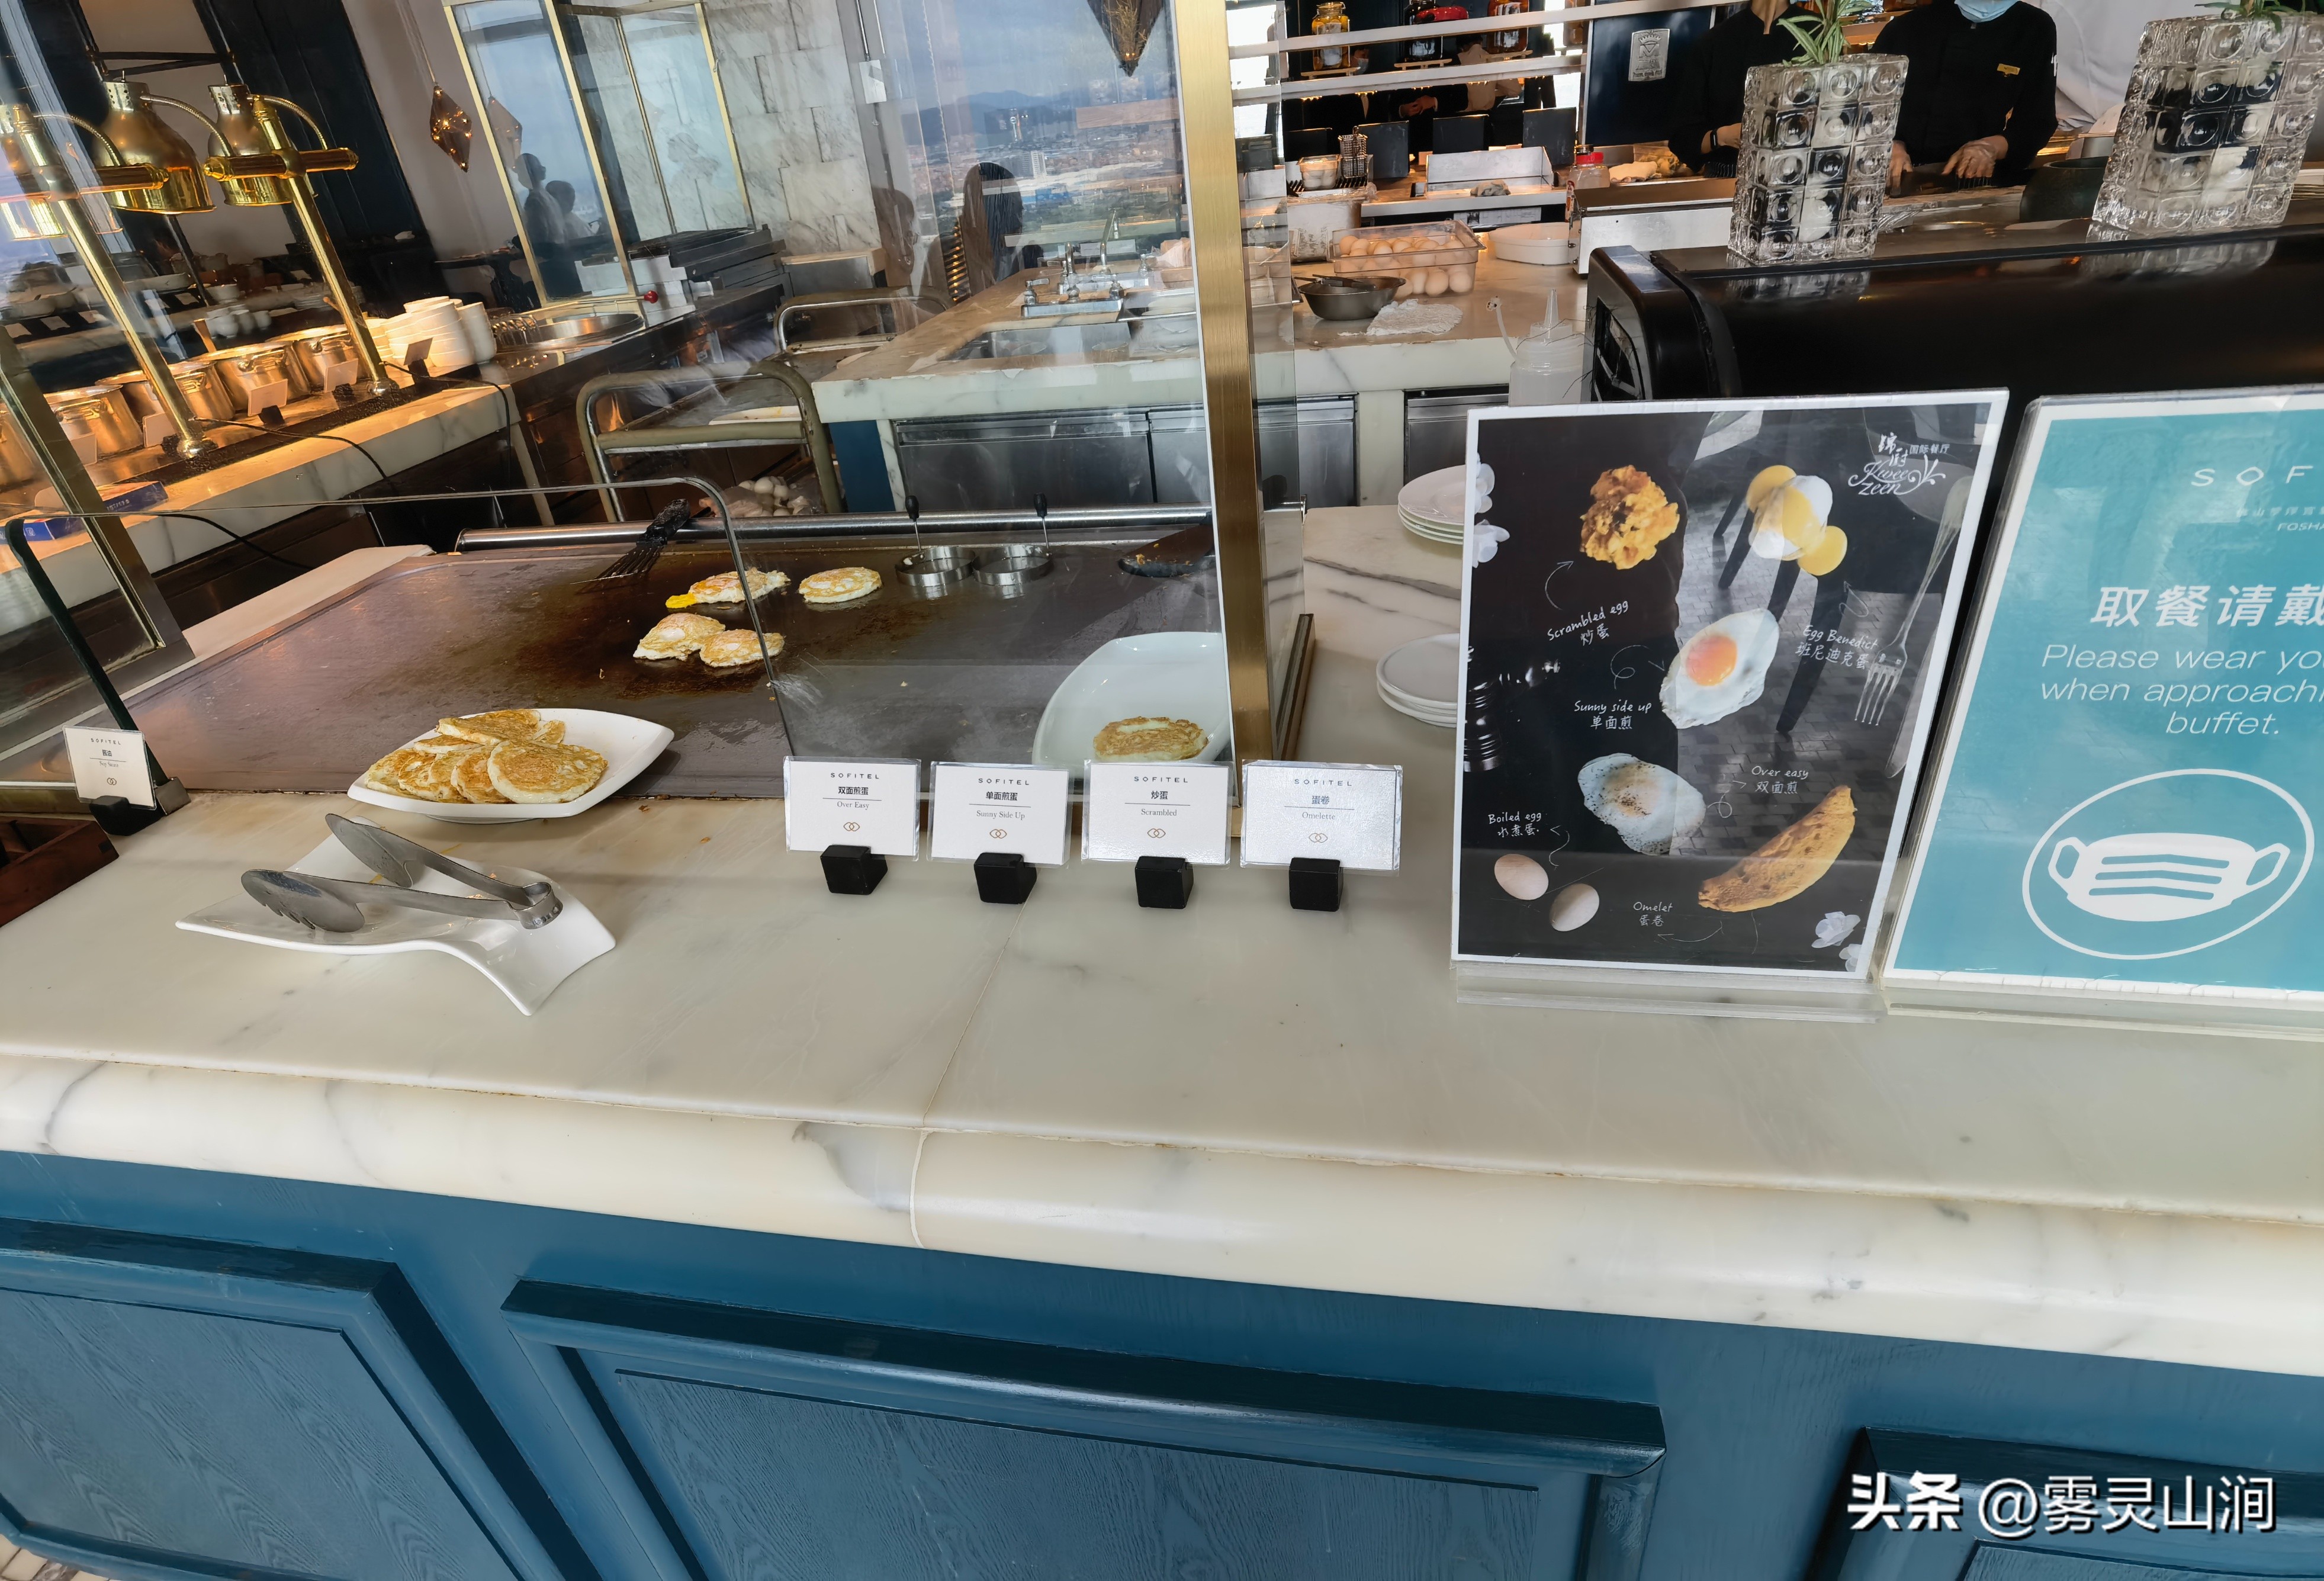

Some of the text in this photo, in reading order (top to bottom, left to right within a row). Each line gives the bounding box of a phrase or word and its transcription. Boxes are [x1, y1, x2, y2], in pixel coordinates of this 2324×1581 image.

[2091, 583, 2324, 627] 取餐请戴
[1547, 600, 1629, 641] Scrambled egg
[1580, 623, 1609, 646] 炒蛋
[1803, 625, 1878, 650] Egg Benedict
[1795, 641, 1869, 670] 班尼迪克蛋
[2042, 644, 2324, 675] Please wear yo
[2042, 678, 2130, 701] when
[1574, 699, 1652, 714] Sunny side up
[1590, 715, 1632, 730] 单面煎
[2166, 711, 2280, 734] buffet.
[1751, 766, 1809, 779] Over easy
[838, 786, 869, 795] 双面煎蛋
[1754, 780, 1798, 794] 双面煎
[985, 791, 1018, 801] 单面煎蛋
[1151, 790, 1168, 800] 炒蛋
[1312, 795, 1330, 805] 蛋卷
[854, 801, 870, 811] Easy
[976, 810, 998, 820] Sunny
[1015, 812, 1026, 821] Up
[1302, 811, 1336, 820] Omelette
[1488, 811, 1541, 824] Boiled egg
[1497, 823, 1536, 837] 水煮蛋
[1633, 901, 1673, 912] Omelet
[1639, 914, 1664, 927] 蛋卷
